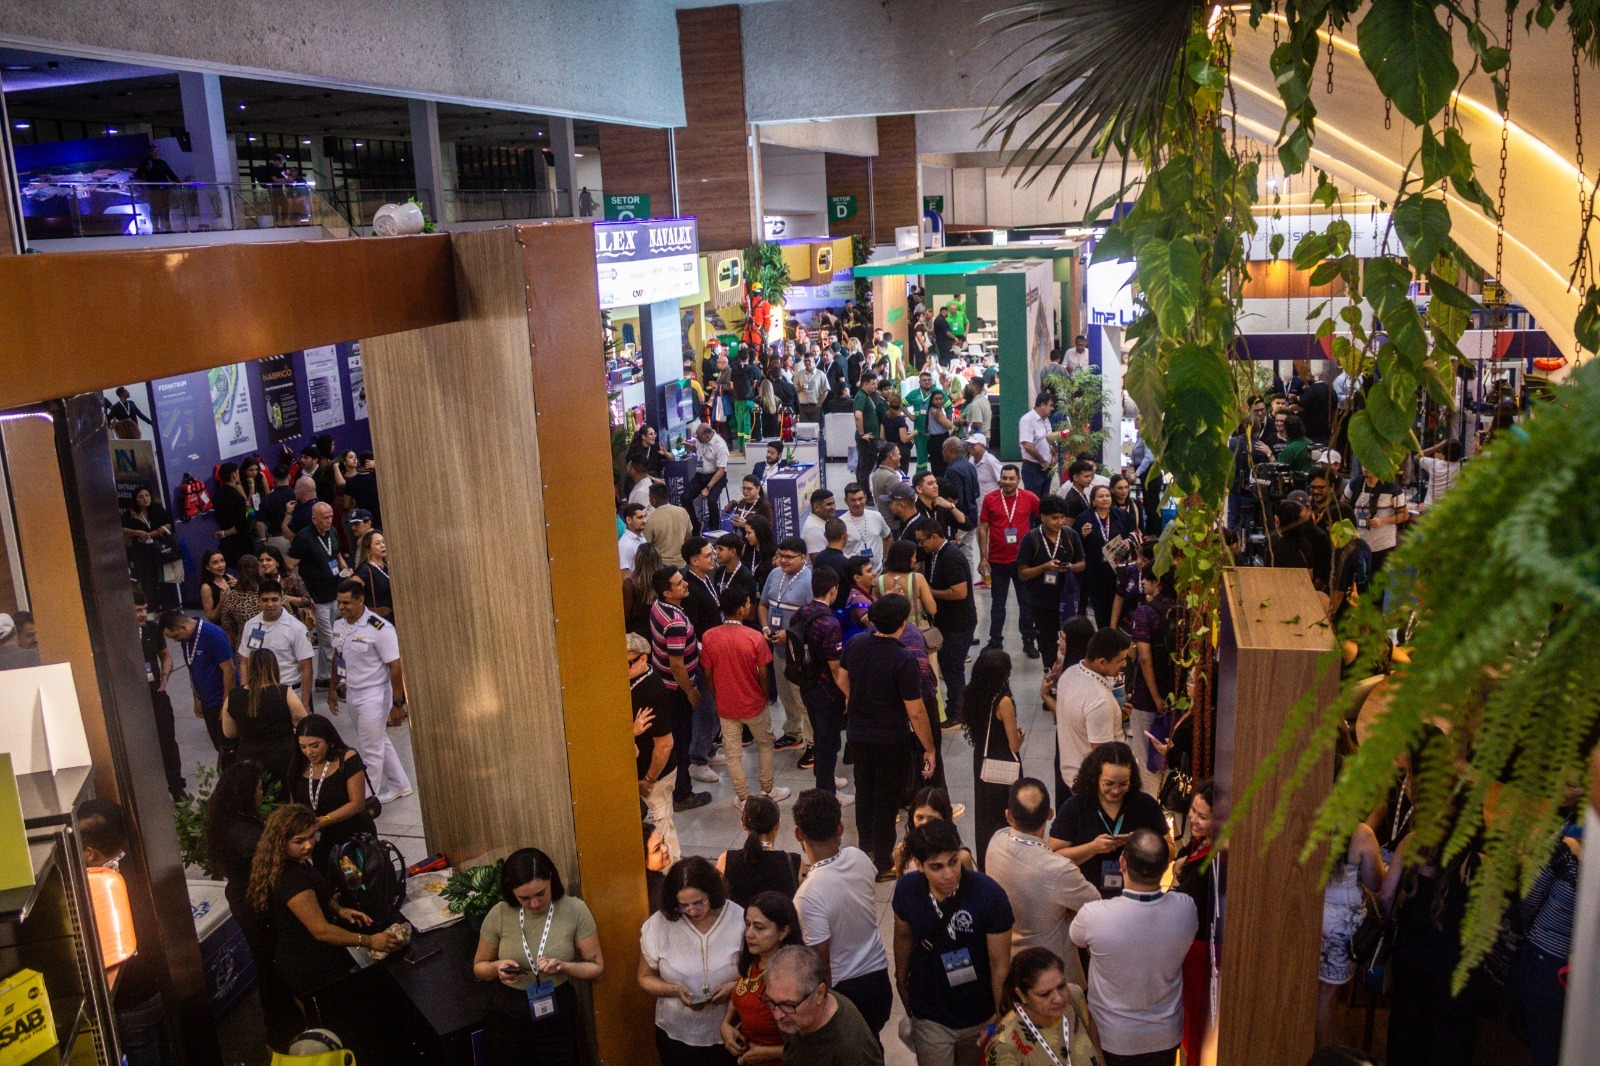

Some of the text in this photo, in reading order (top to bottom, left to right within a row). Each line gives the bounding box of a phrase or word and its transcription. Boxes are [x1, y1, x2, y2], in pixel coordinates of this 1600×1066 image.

[611, 196, 640, 204] SETOR
[836, 205, 848, 218] D
[596, 229, 638, 252] LEX
[649, 226, 693, 248] NAVALEX
[263, 369, 292, 381] NABRICO
[158, 380, 187, 392] FERNSTRUM
[0, 1008, 45, 1050] SAB
[19, 1023, 47, 1044] GAS FREE
